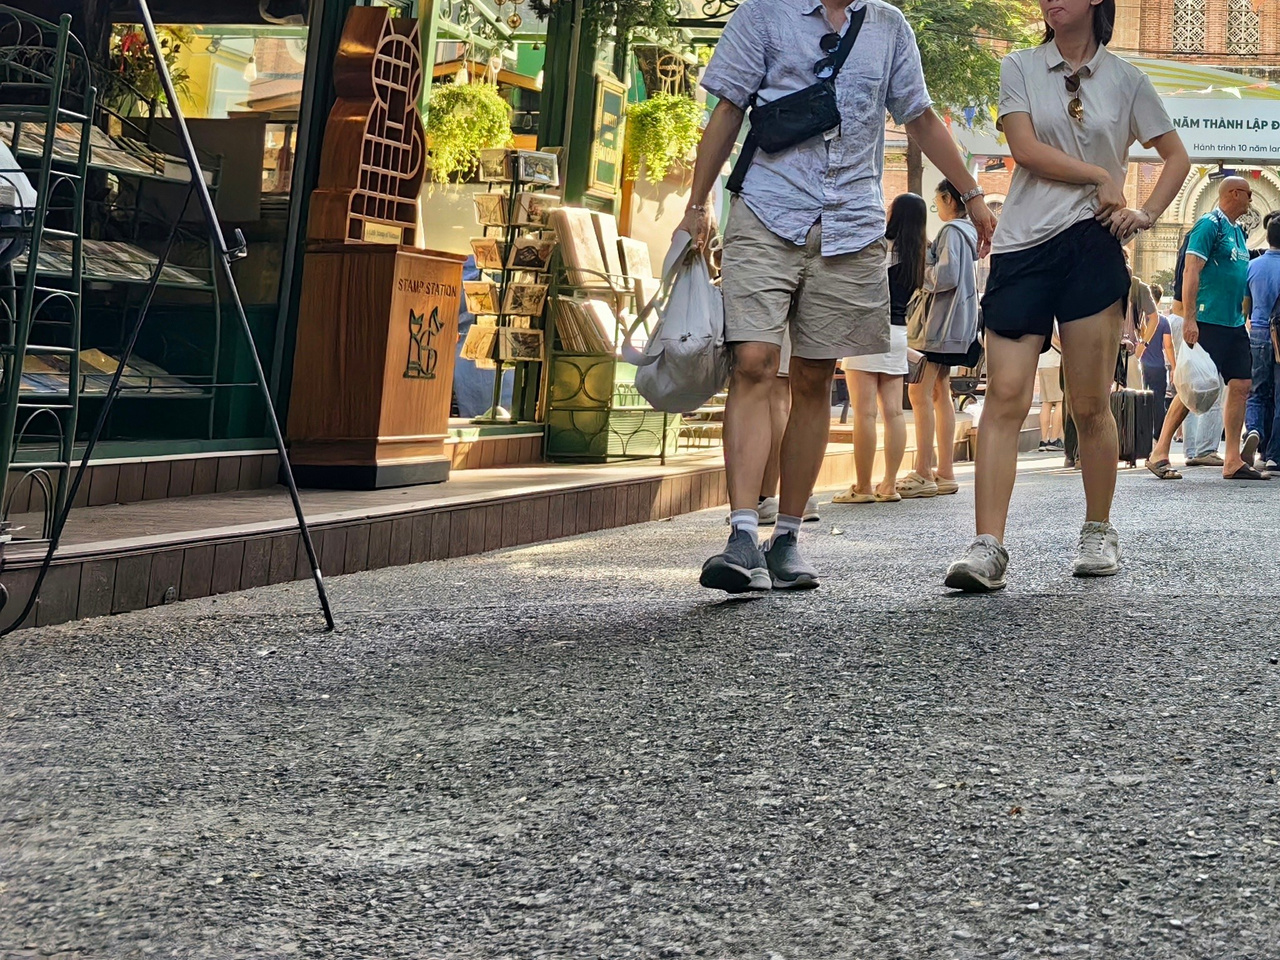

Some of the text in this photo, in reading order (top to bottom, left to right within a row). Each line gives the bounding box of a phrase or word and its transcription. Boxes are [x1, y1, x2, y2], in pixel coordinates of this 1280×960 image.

[1172, 115, 1200, 129] NĂM
[1202, 117, 1243, 130] THÀNH
[1246, 117, 1269, 133] LẬP
[1238, 144, 1247, 152] 10
[1249, 144, 1268, 153] năm
[398, 278, 457, 297] STAMP STATION
